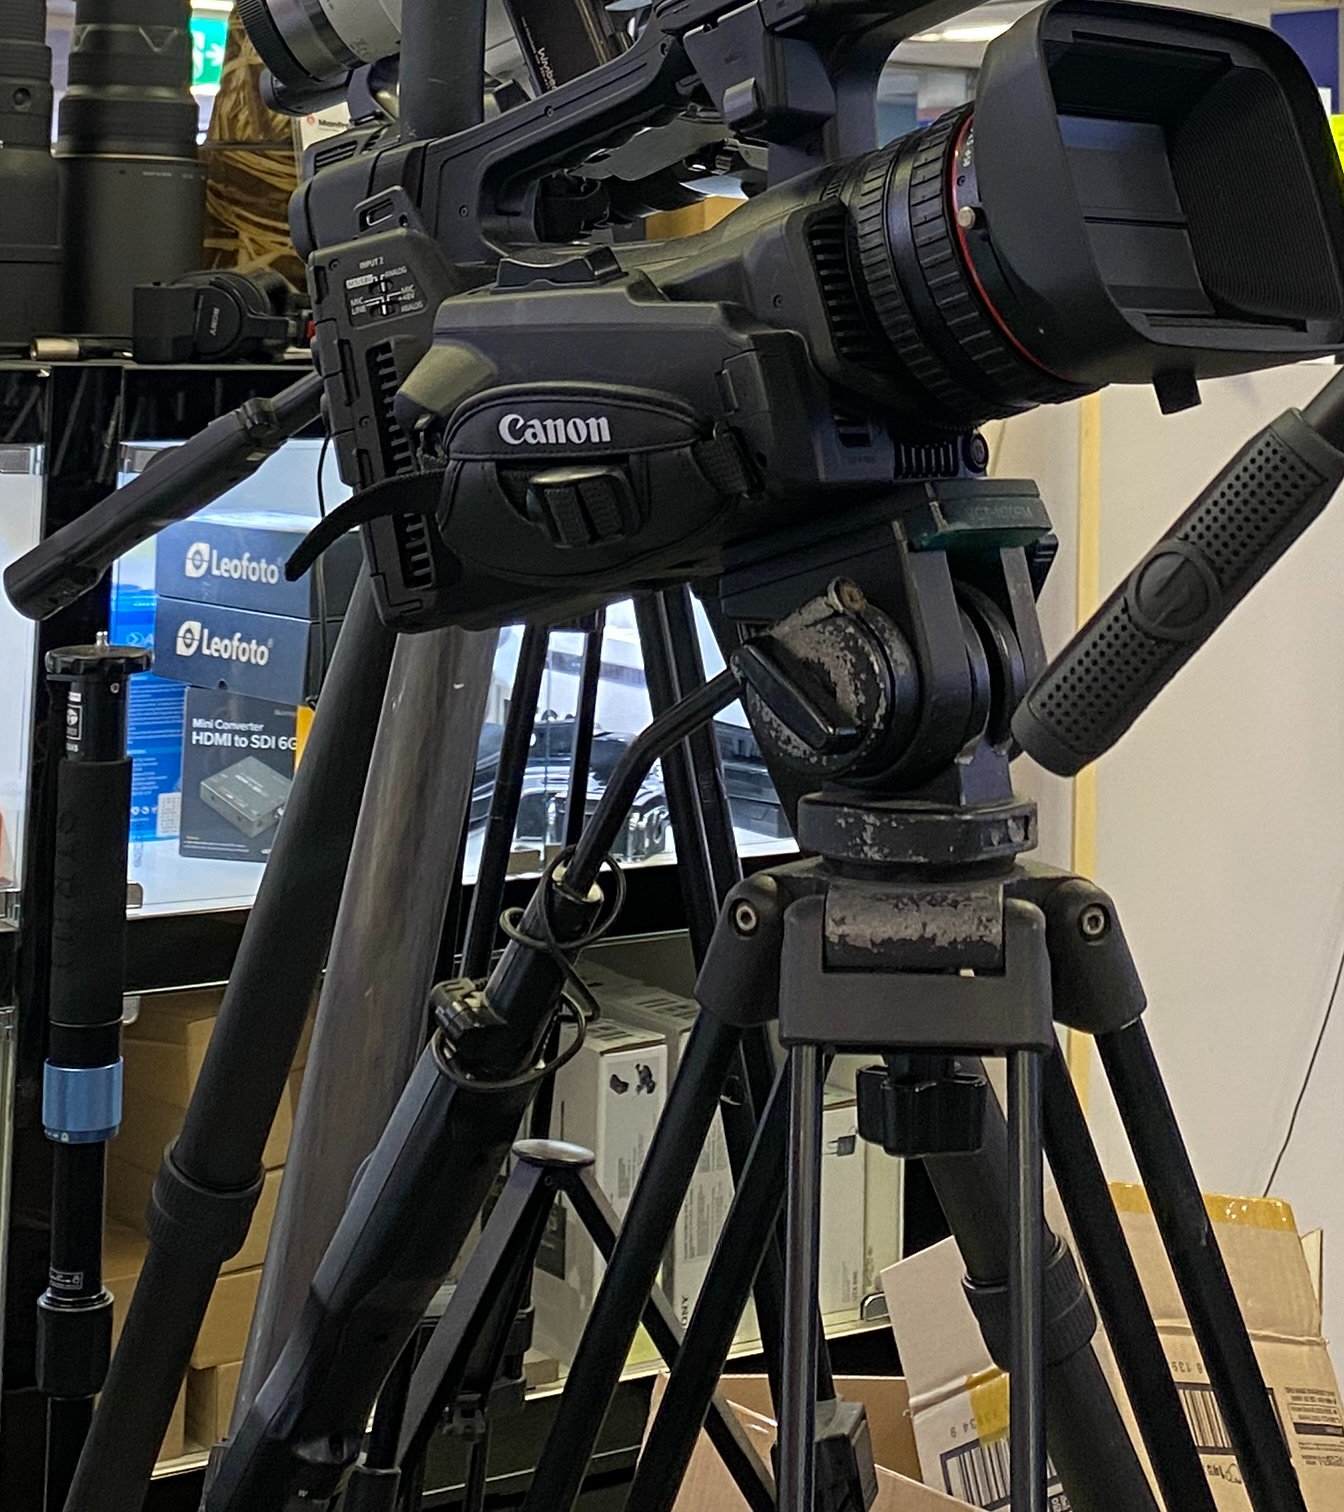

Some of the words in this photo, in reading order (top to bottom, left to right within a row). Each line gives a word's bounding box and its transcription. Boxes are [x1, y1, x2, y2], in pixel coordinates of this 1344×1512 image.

[498, 412, 612, 446] Canon
[211, 549, 280, 585] Leofoto
[201, 628, 270, 666] Leofoto
[191, 731, 232, 747] HDMI
[233, 735, 248, 748] to
[249, 735, 276, 750] SDI
[192, 718, 214, 729] Mini
[214, 719, 265, 732] Converter
